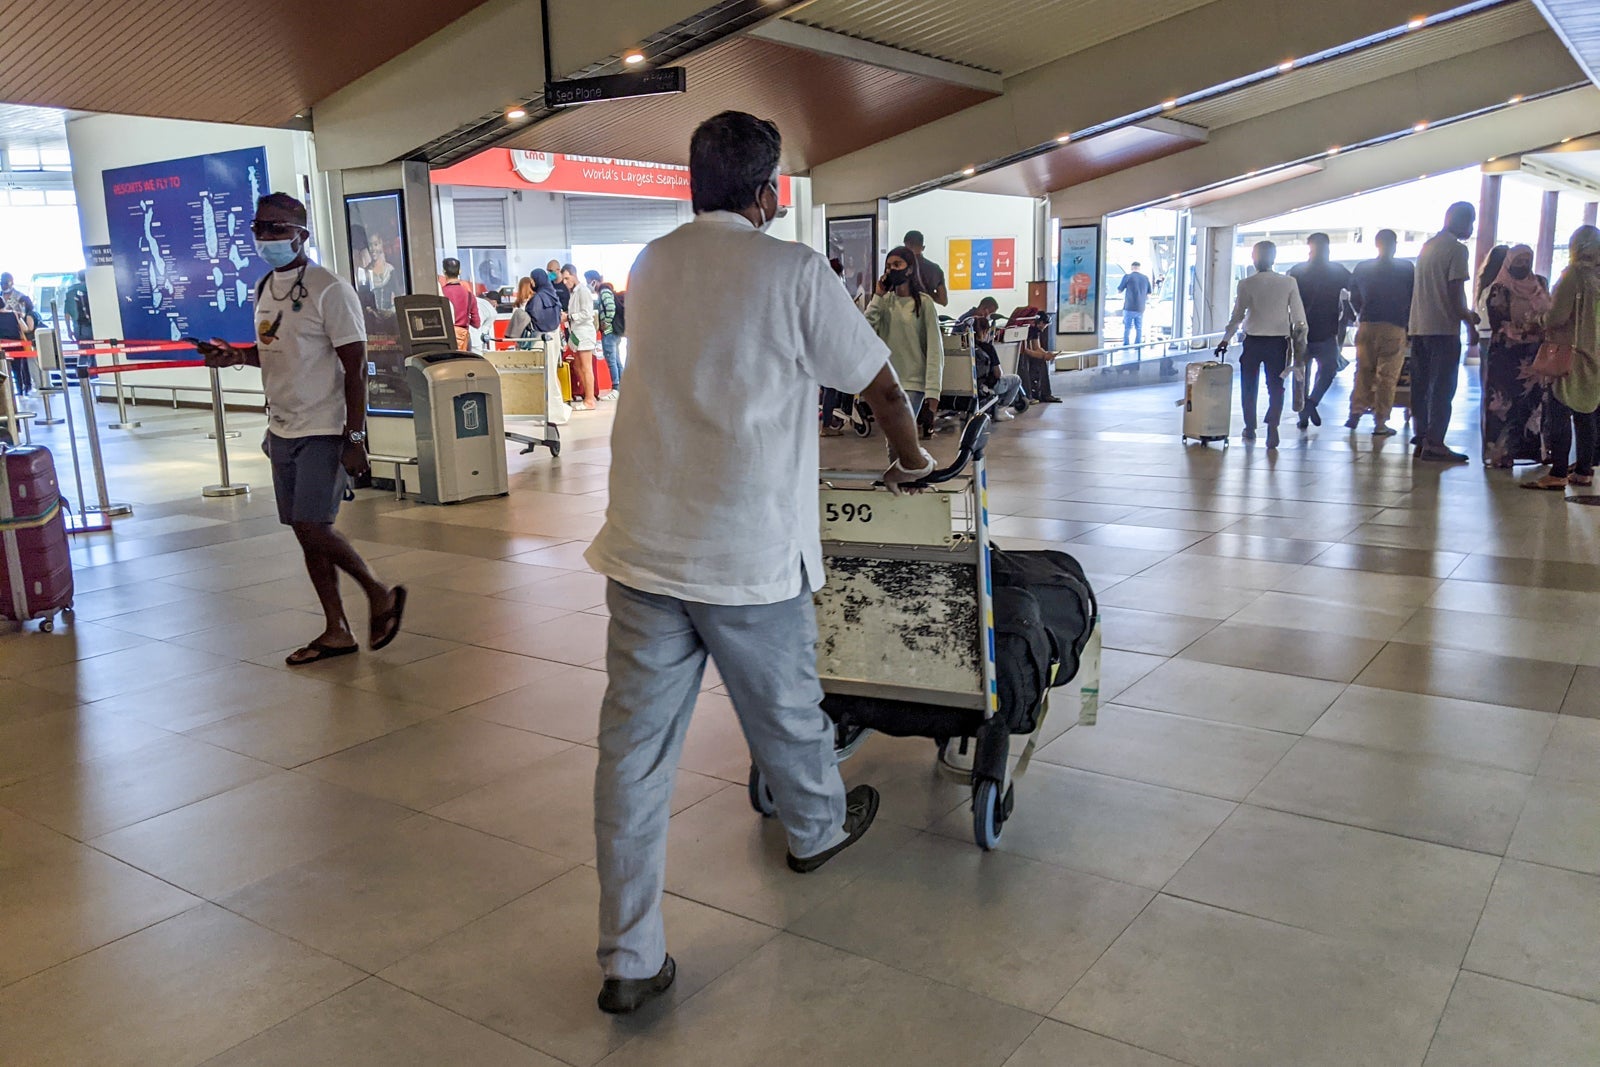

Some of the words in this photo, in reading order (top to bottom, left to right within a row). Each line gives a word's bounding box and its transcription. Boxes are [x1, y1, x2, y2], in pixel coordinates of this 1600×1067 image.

[556, 91, 574, 102] Sea
[575, 88, 602, 98] Plane
[113, 181, 143, 195] RESORTS
[144, 179, 156, 191] WE
[156, 178, 168, 190] FLY
[169, 176, 181, 188] TO
[582, 168, 619, 180] World's
[621, 172, 654, 187] Largest
[826, 503, 872, 522] 590
